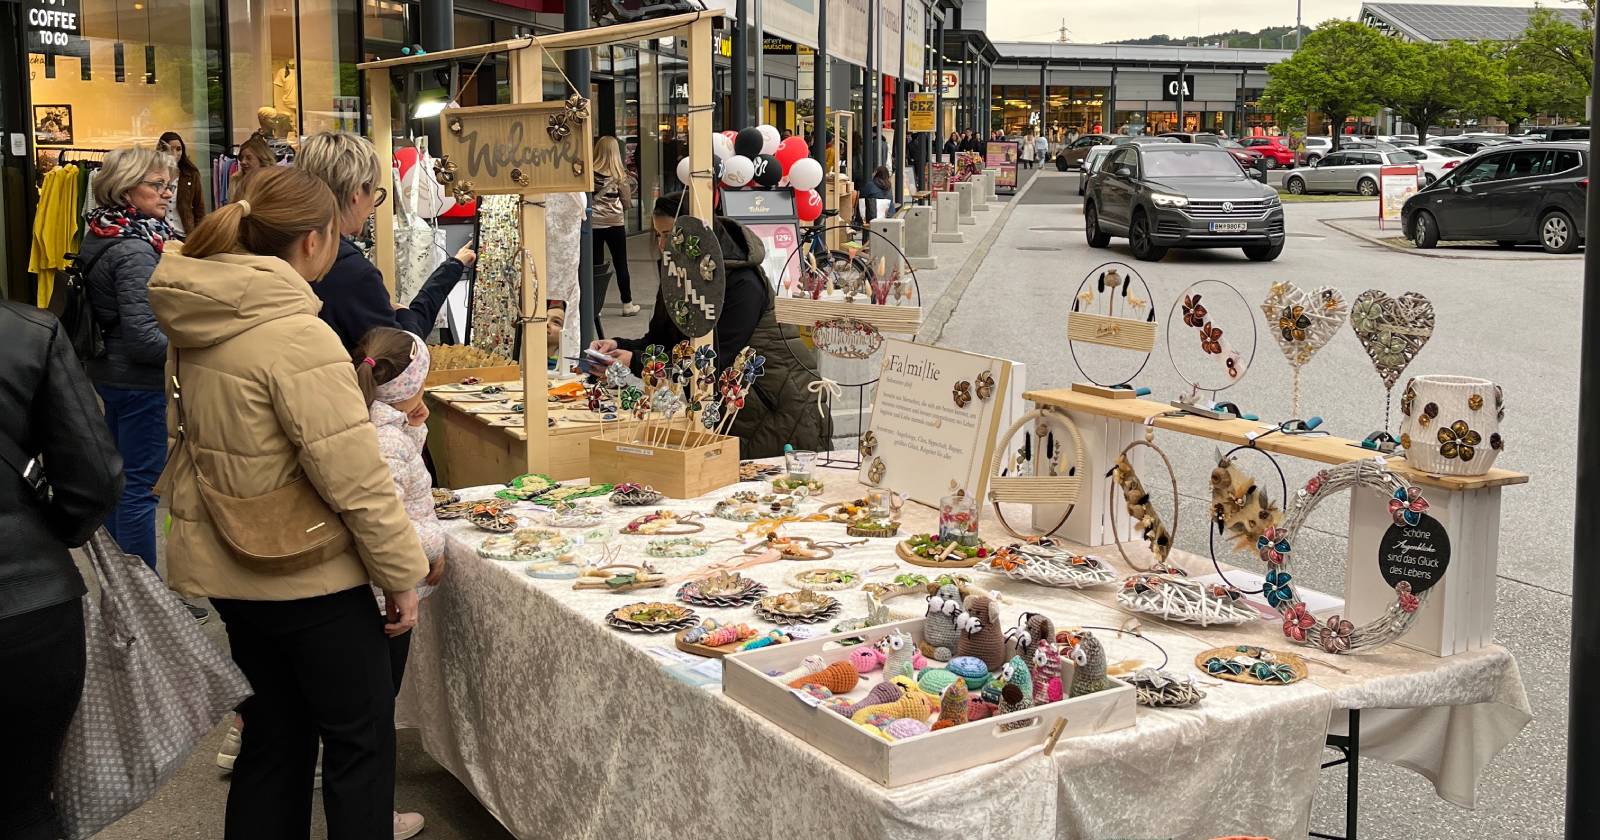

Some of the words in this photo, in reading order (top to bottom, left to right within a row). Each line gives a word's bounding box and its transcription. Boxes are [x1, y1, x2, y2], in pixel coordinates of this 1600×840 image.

[30, 8, 77, 30] COFFEE
[40, 30, 53, 45] TO
[54, 31, 69, 46] GO
[458, 121, 582, 178] Welcome
[663, 250, 716, 320] FAMILIE
[1403, 528, 1431, 539] Schöne
[1387, 553, 1402, 563] sind
[1403, 554, 1416, 564] das
[1417, 556, 1439, 568] Glück
[1390, 566, 1402, 575] des
[1403, 567, 1431, 580] Lebens
